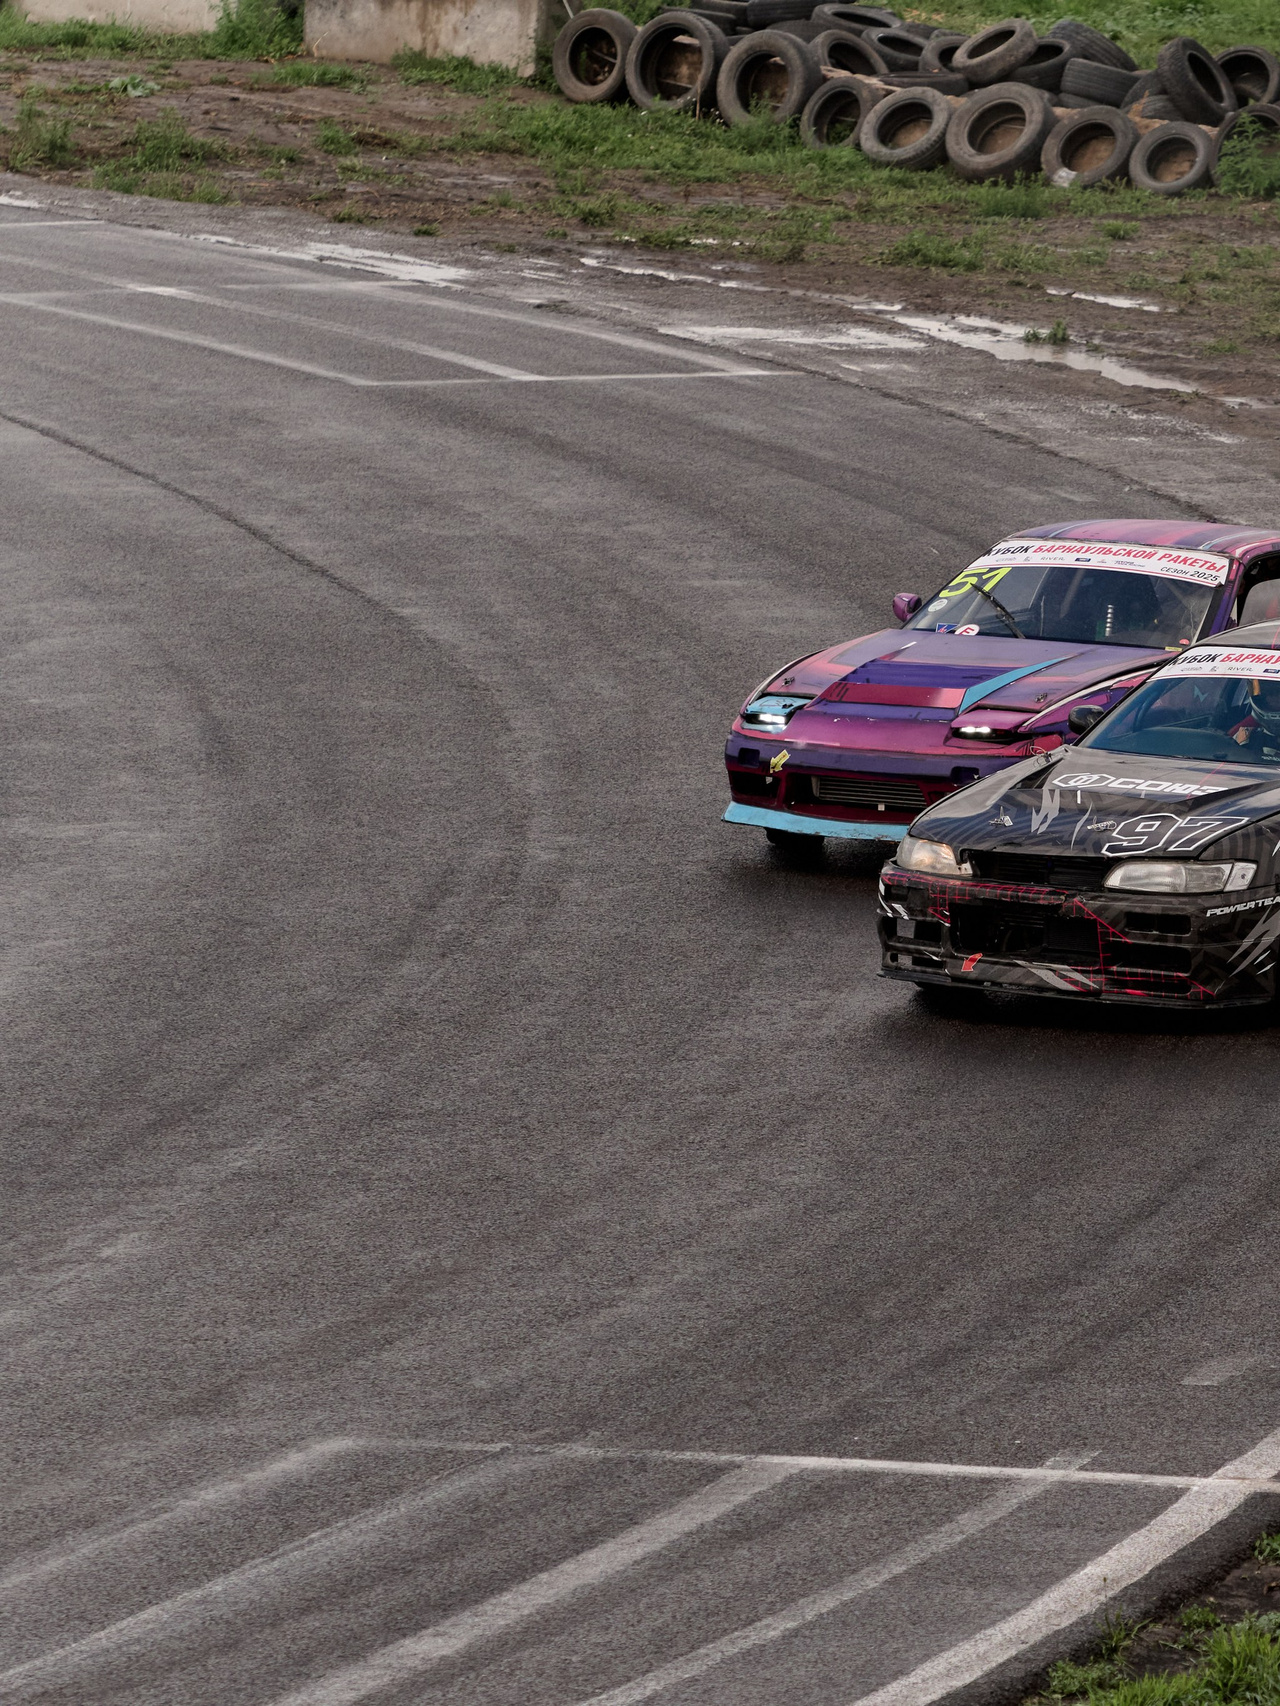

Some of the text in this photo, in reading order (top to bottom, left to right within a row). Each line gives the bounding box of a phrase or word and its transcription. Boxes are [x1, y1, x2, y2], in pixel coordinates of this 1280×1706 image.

[1032, 544, 1158, 560] БАРНАУЛЬСКОЙ
[1157, 553, 1226, 573] РАКЕТЫ
[939, 567, 1012, 597] 51
[1160, 566, 1220, 582] СЕЗОН 2025
[1107, 777, 1228, 796] СОЮЗ
[1101, 813, 1249, 857] 97
